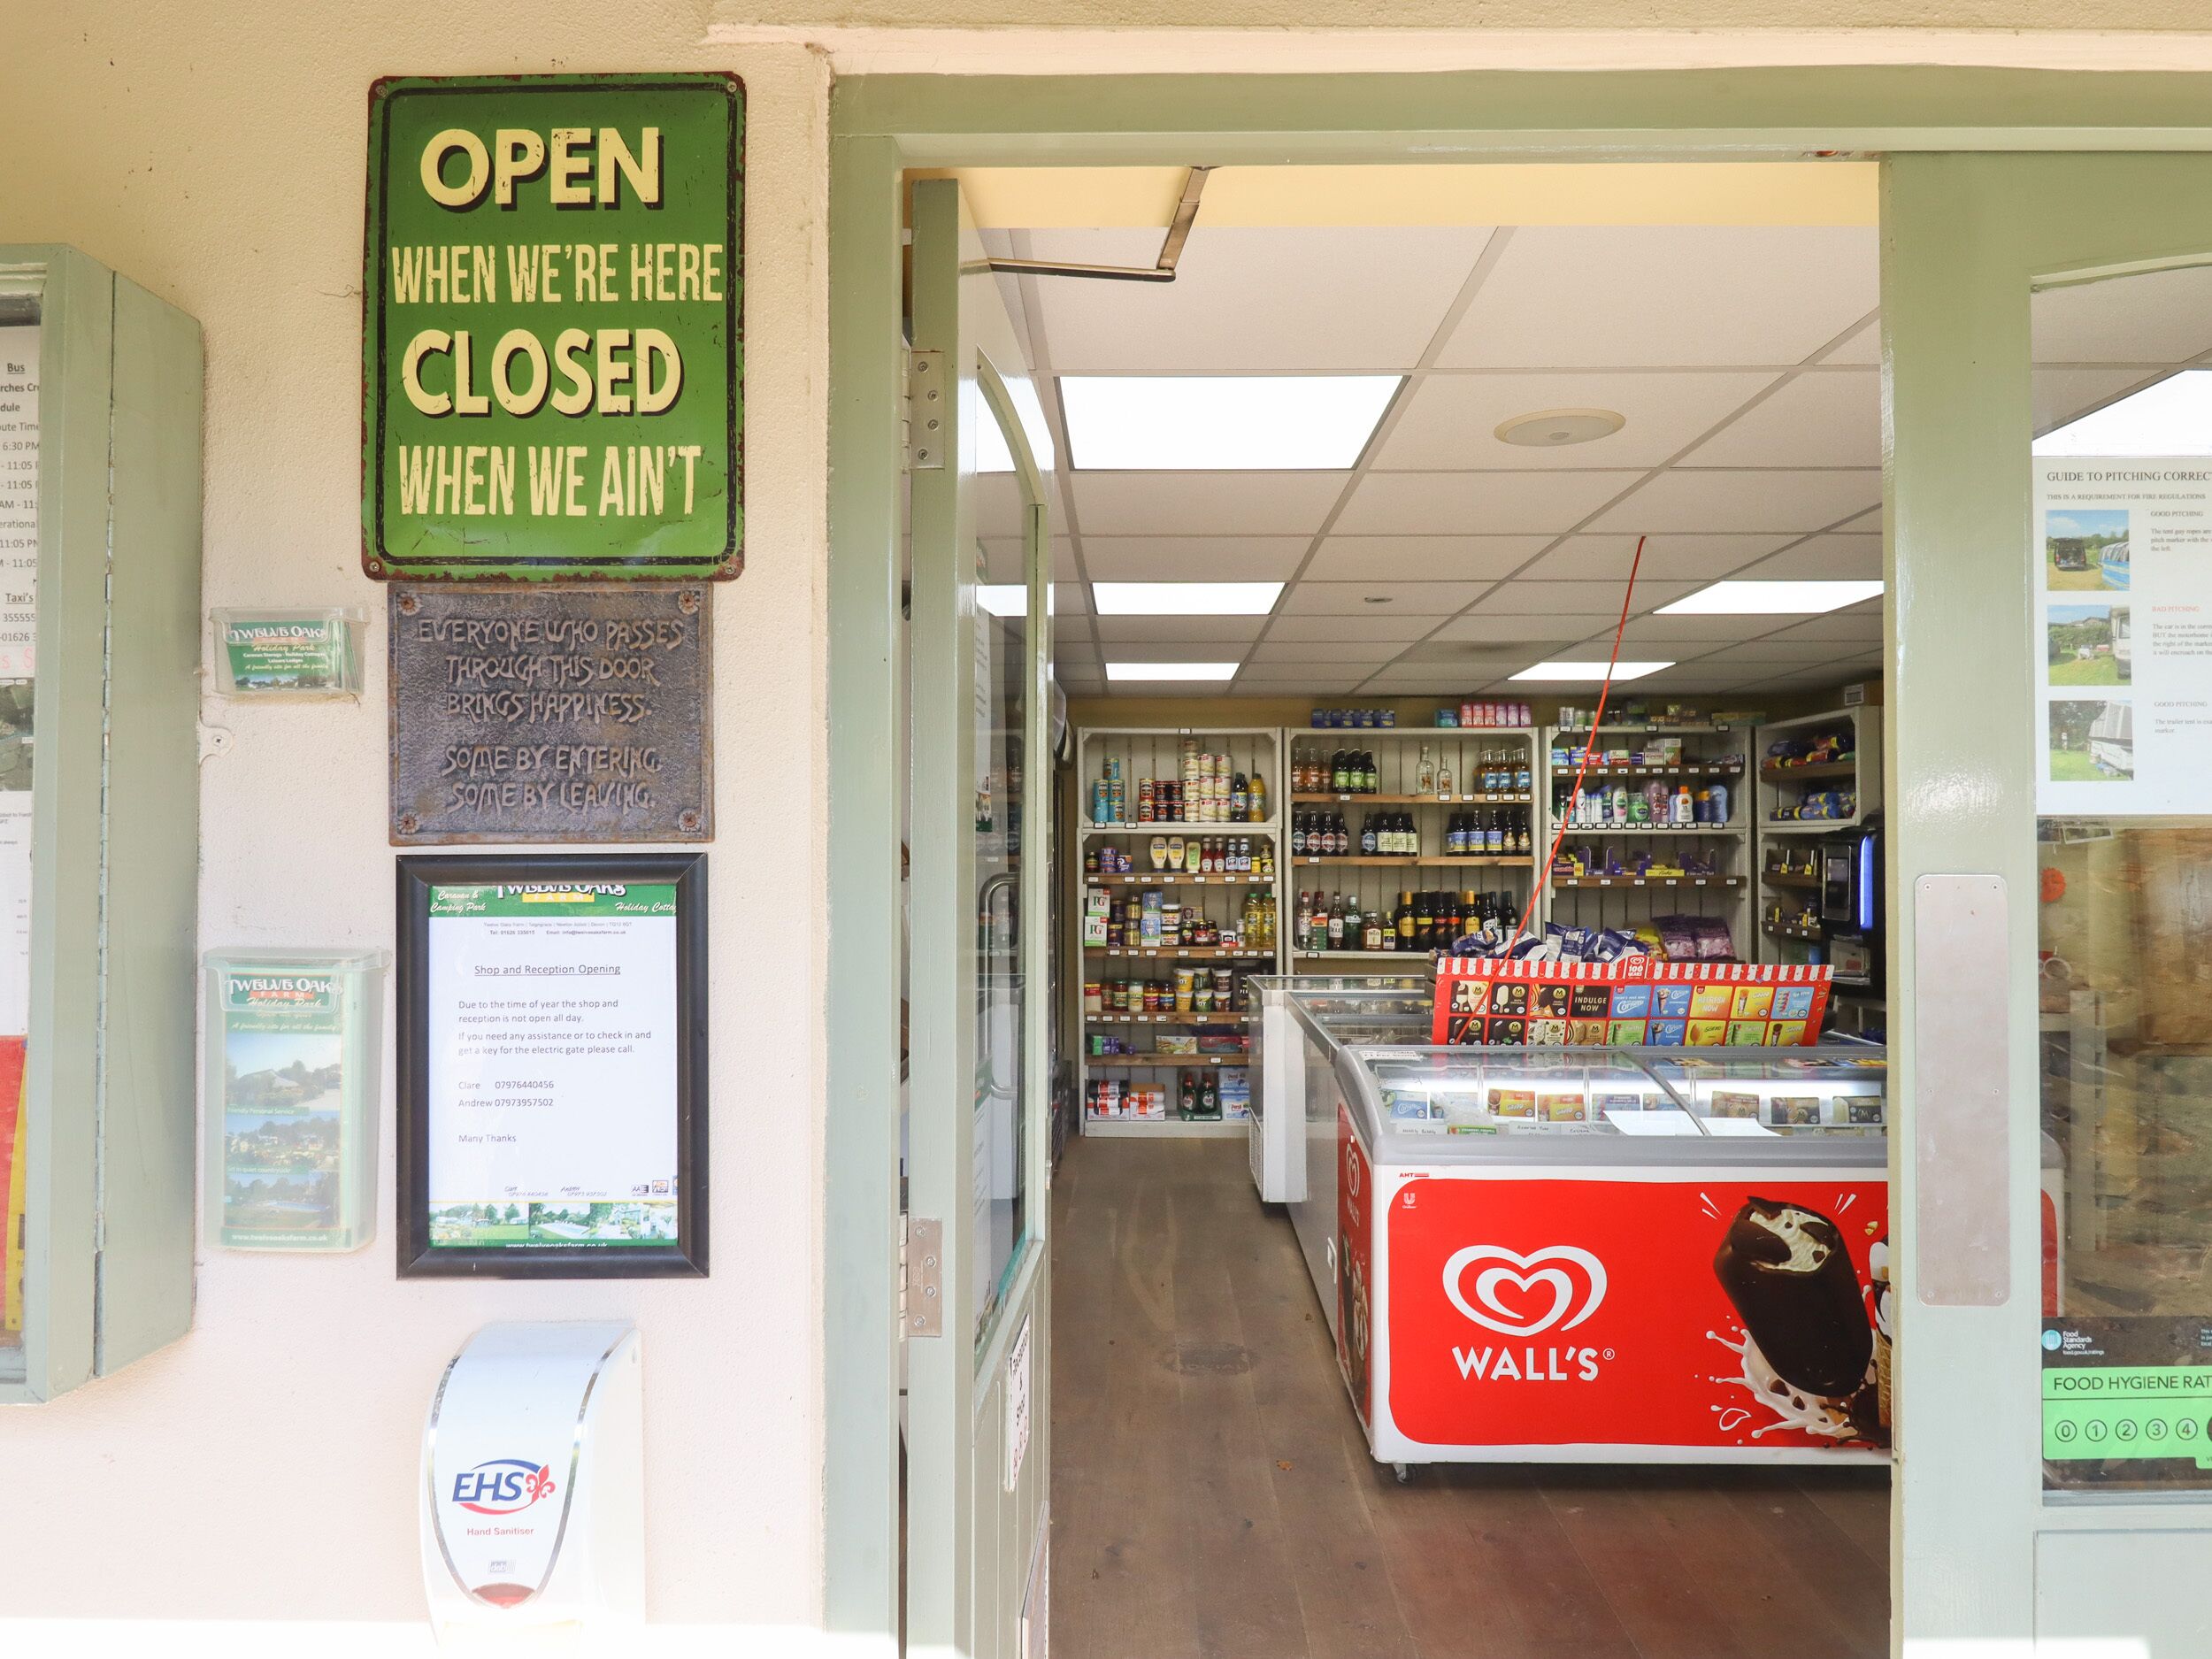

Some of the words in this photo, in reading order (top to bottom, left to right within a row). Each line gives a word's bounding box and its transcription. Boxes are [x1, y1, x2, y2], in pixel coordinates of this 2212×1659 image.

[419, 127, 661, 208] OPEN
[391, 245, 495, 303] WHEN
[507, 243, 618, 303] WE'RE
[630, 242, 723, 302] HERE
[7, 363, 26, 374] Bus
[401, 328, 683, 416] CLOSED
[3, 442, 23, 451] 6:30
[7, 461, 33, 470] 11:05
[398, 445, 515, 515] WHEN
[527, 445, 587, 517] WE
[598, 444, 702, 517] AIN'T
[2047, 472, 2084, 482] GUIDE
[2086, 472, 2103, 482] TO
[2105, 472, 2161, 481] PITCHING
[7, 480, 33, 489] 11:05
[0, 539, 24, 549] 11:05
[5, 592, 34, 605] Taxi's
[231, 626, 289, 641] TWELVE
[419, 618, 541, 651] EVERYONE
[544, 618, 598, 651] WHO
[605, 618, 686, 651] PASSES
[446, 655, 543, 688] THROUGH
[549, 655, 596, 688] THIS
[598, 657, 663, 687] DOOR
[446, 690, 528, 724] BRINGS
[442, 744, 513, 778] SOME
[515, 744, 550, 772] BY
[447, 780, 518, 815] SOME
[522, 781, 557, 809] BY
[438, 890, 470, 901] Caravan
[472, 890, 480, 899] &
[1093, 896, 1105, 907] PG
[430, 902, 465, 913] Camping
[466, 902, 487, 912] Park
[615, 902, 649, 913] Holiday
[1089, 924, 1102, 935] PG
[474, 965, 501, 976] Shop
[503, 965, 521, 974] and
[525, 965, 575, 976] Reception
[578, 964, 621, 975] Opening
[227, 978, 295, 995] TWELVE
[458, 1001, 477, 1010] Due
[541, 1002, 560, 1010] year
[579, 1000, 600, 1010] shop
[602, 999, 618, 1008] and
[1574, 996, 1608, 1005] INDULGE
[458, 1015, 501, 1025] reception
[528, 1016, 551, 1025] open
[553, 1014, 564, 1023] all
[565, 1014, 585, 1024] day.
[458, 1031, 465, 1040] If
[466, 1033, 483, 1042] you
[486, 1031, 508, 1040] need
[510, 1033, 526, 1042] any
[527, 1031, 572, 1040] assistance
[597, 1031, 623, 1040] check
[625, 1031, 633, 1040] in
[634, 1031, 651, 1040] and
[458, 1048, 472, 1057] get
[482, 1046, 498, 1056] key
[565, 1047, 585, 1056] gate
[588, 1045, 616, 1056] please
[458, 1080, 480, 1090] Clare
[495, 1080, 555, 1090] 07976440456
[458, 1098, 493, 1107] Andrew
[495, 1098, 554, 1107] 07973957502
[458, 1134, 483, 1144] Many
[486, 1133, 517, 1142] Thanks
[1451, 1346, 1600, 1382] WALL'S
[2054, 1377, 2104, 1391] FOOD
[2108, 1375, 2178, 1390] HYGIENE
[2061, 1425, 2070, 1438] 0
[2092, 1425, 2099, 1438] 1
[2122, 1424, 2131, 1437] 2
[2152, 1424, 2161, 1436] 3
[2182, 1423, 2191, 1435] 4
[451, 1472, 525, 1502] EHS
[466, 1526, 491, 1536] Hand
[493, 1526, 534, 1536] Sanitiser
